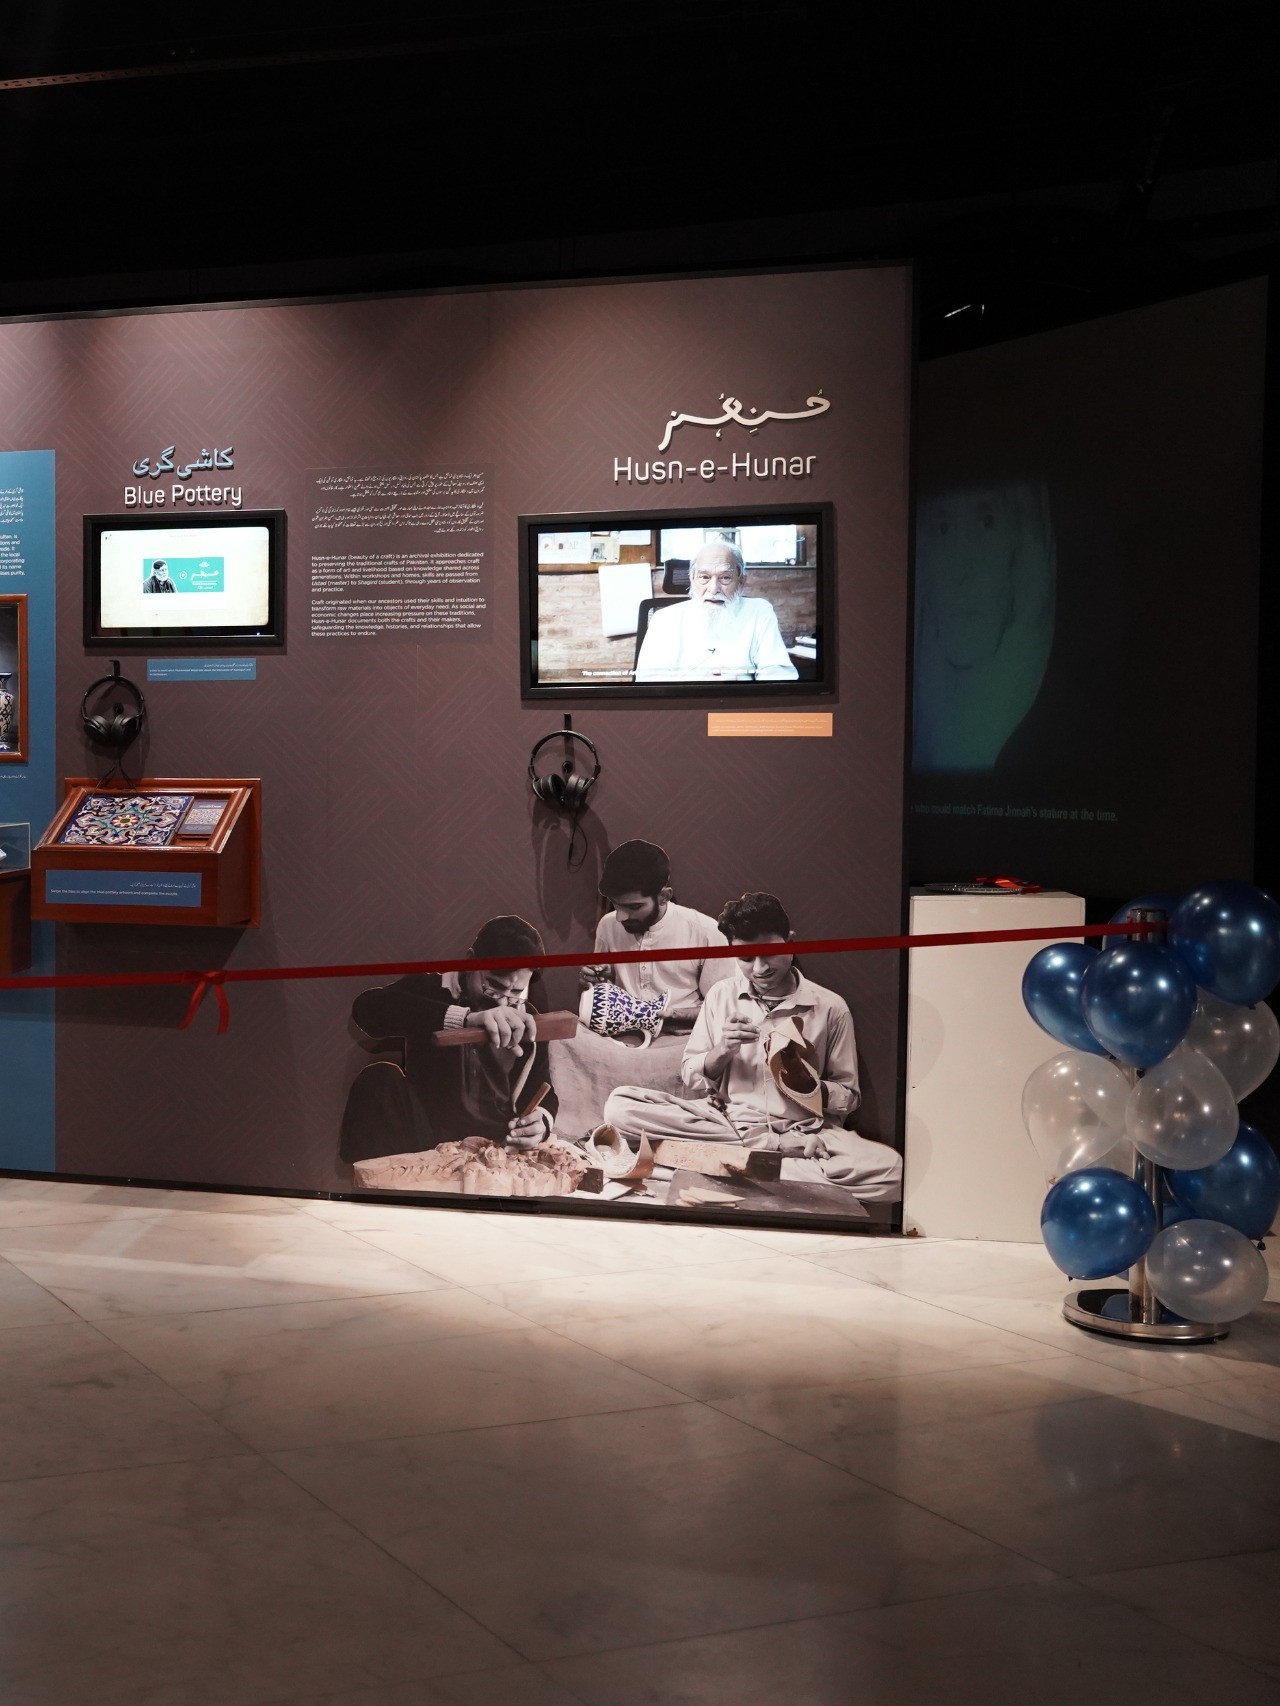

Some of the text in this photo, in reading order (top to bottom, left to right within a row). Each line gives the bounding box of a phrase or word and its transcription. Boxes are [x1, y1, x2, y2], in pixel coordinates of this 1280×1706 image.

[133, 446, 233, 477] کاشی گری
[614, 453, 817, 482] Husn-e-Hunar
[124, 485, 242, 506] Blue Pottery
